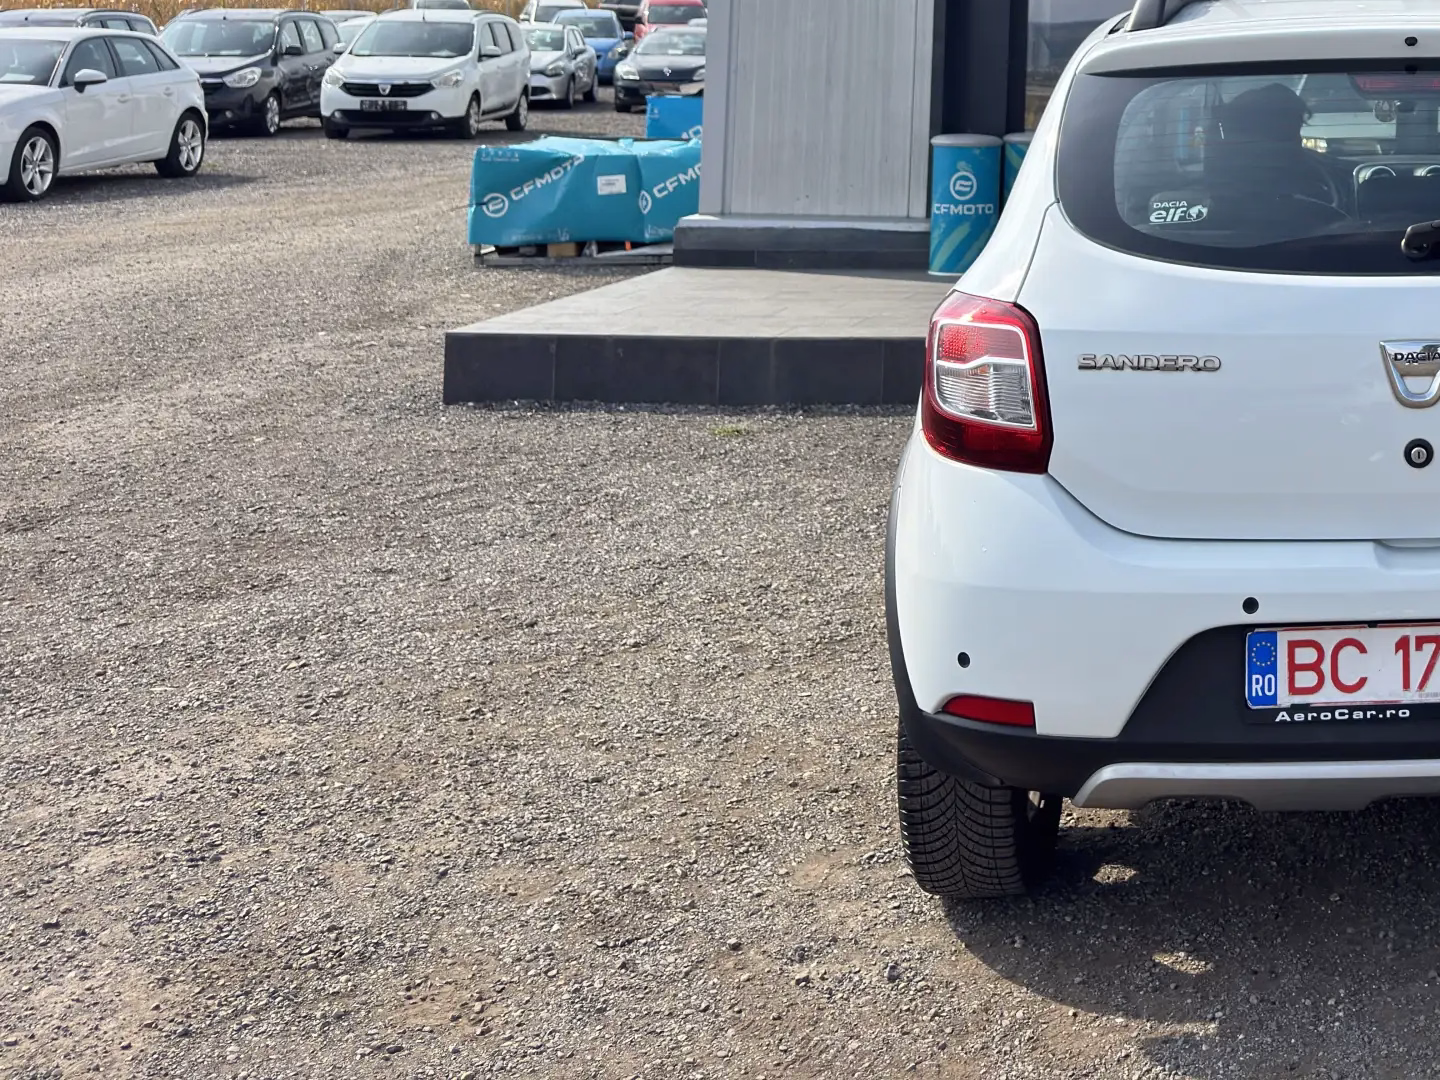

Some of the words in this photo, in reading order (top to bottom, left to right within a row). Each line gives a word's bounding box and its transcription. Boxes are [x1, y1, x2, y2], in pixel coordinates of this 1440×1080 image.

[510, 154, 585, 200] CFMOTO
[653, 163, 702, 198] CFM
[934, 203, 994, 215] CFMOTO
[1153, 201, 1188, 209] DACIA
[1149, 207, 1188, 223] elf
[1078, 354, 1221, 371] SANDERO
[1287, 637, 1368, 696] BC
[1252, 674, 1276, 697] RO
[1275, 707, 1411, 722] AeroCar.ro
